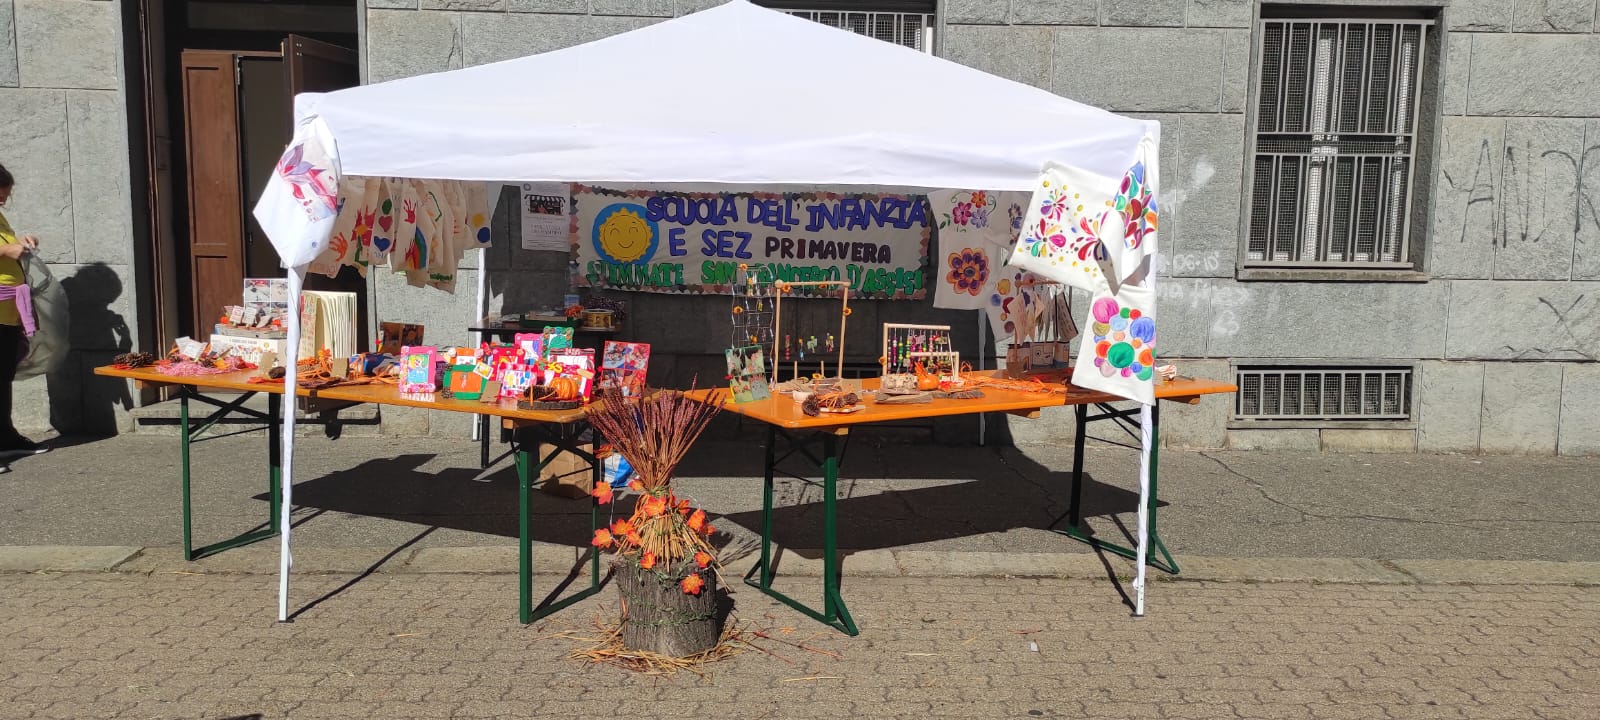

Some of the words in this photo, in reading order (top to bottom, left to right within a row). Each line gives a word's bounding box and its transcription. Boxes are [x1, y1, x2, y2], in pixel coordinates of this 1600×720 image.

[646, 195, 738, 226] SCUOLA
[669, 228, 687, 256] E
[701, 228, 752, 259] SEZ
[765, 237, 891, 264] PRIMAVERA
[701, 260, 738, 284] SAN
